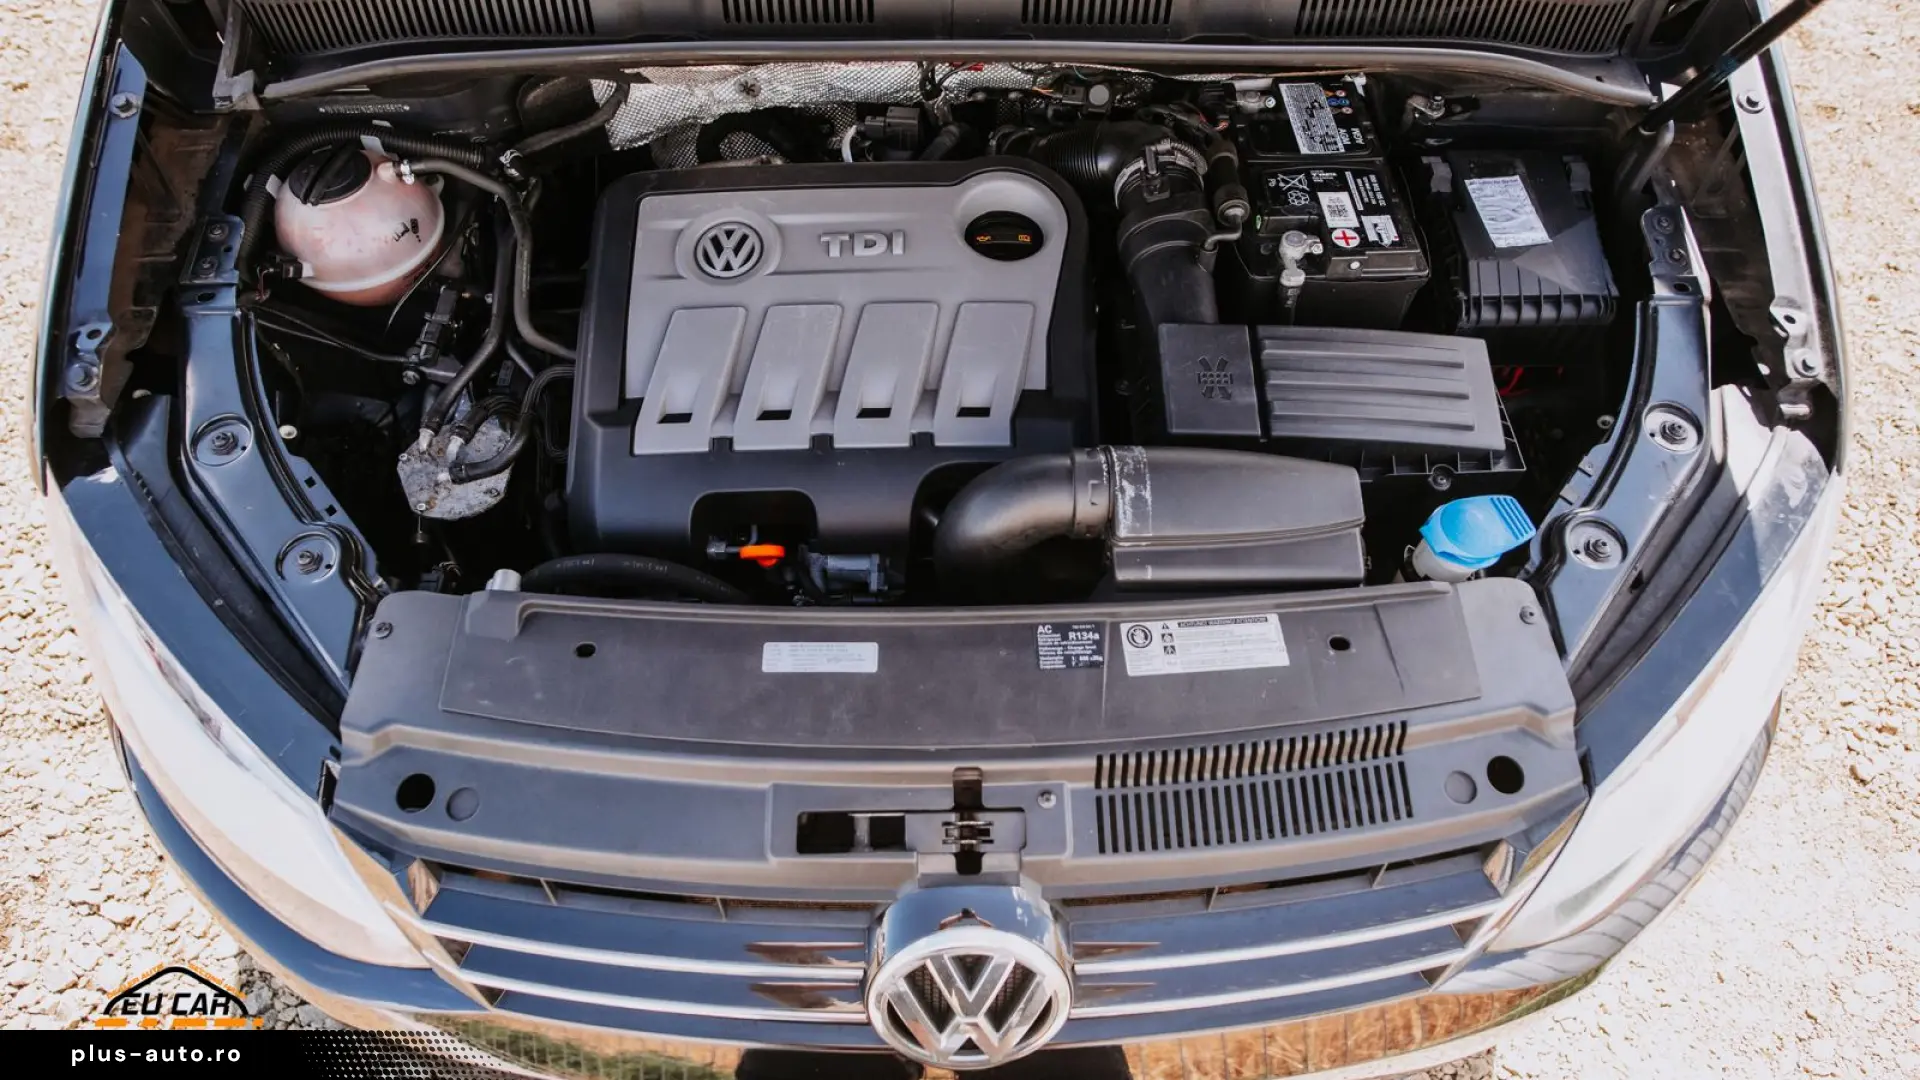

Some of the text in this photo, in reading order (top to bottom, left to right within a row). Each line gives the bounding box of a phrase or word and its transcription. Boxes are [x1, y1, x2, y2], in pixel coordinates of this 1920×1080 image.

[820, 229, 904, 257] TDI
[1037, 624, 1053, 634] AC
[1068, 631, 1100, 640] R134a
